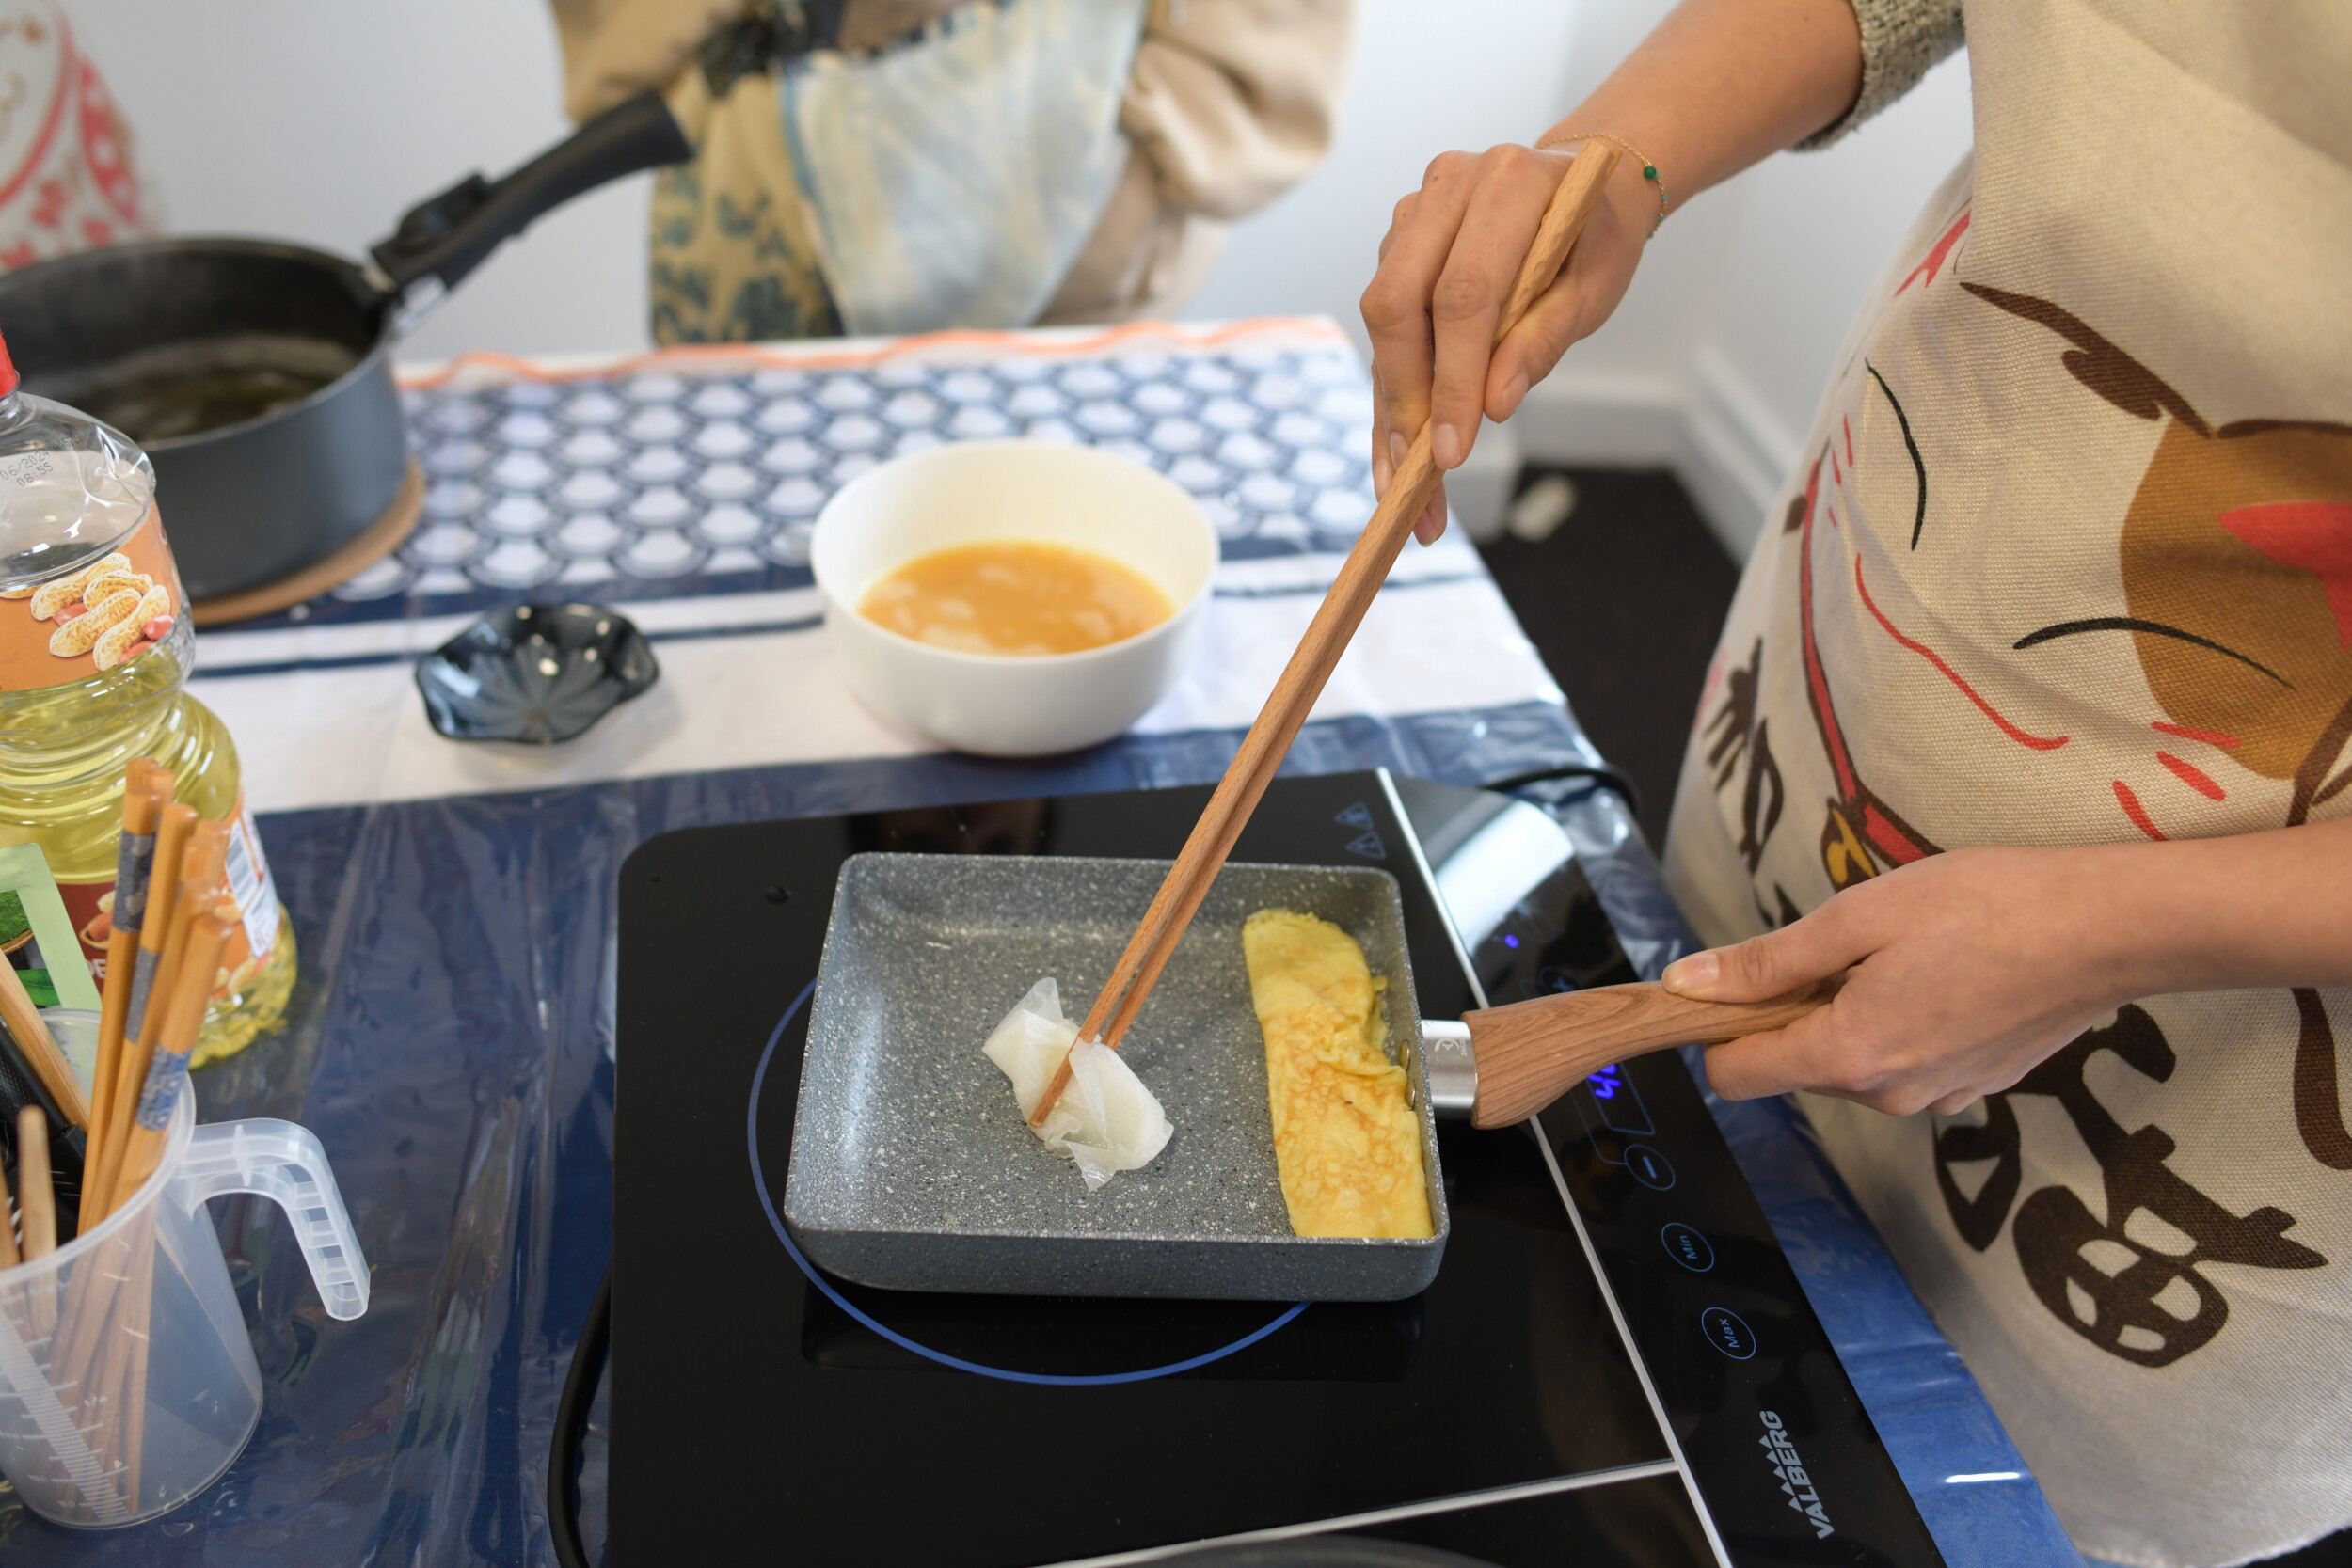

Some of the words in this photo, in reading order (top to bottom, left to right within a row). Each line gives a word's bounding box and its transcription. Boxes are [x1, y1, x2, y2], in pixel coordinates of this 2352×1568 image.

[16, 462, 54, 486] 08:55
[1679, 1235, 1697, 1259] Min
[1719, 1318, 1740, 1348] Max
[1758, 1410, 1835, 1540] VALBERG
